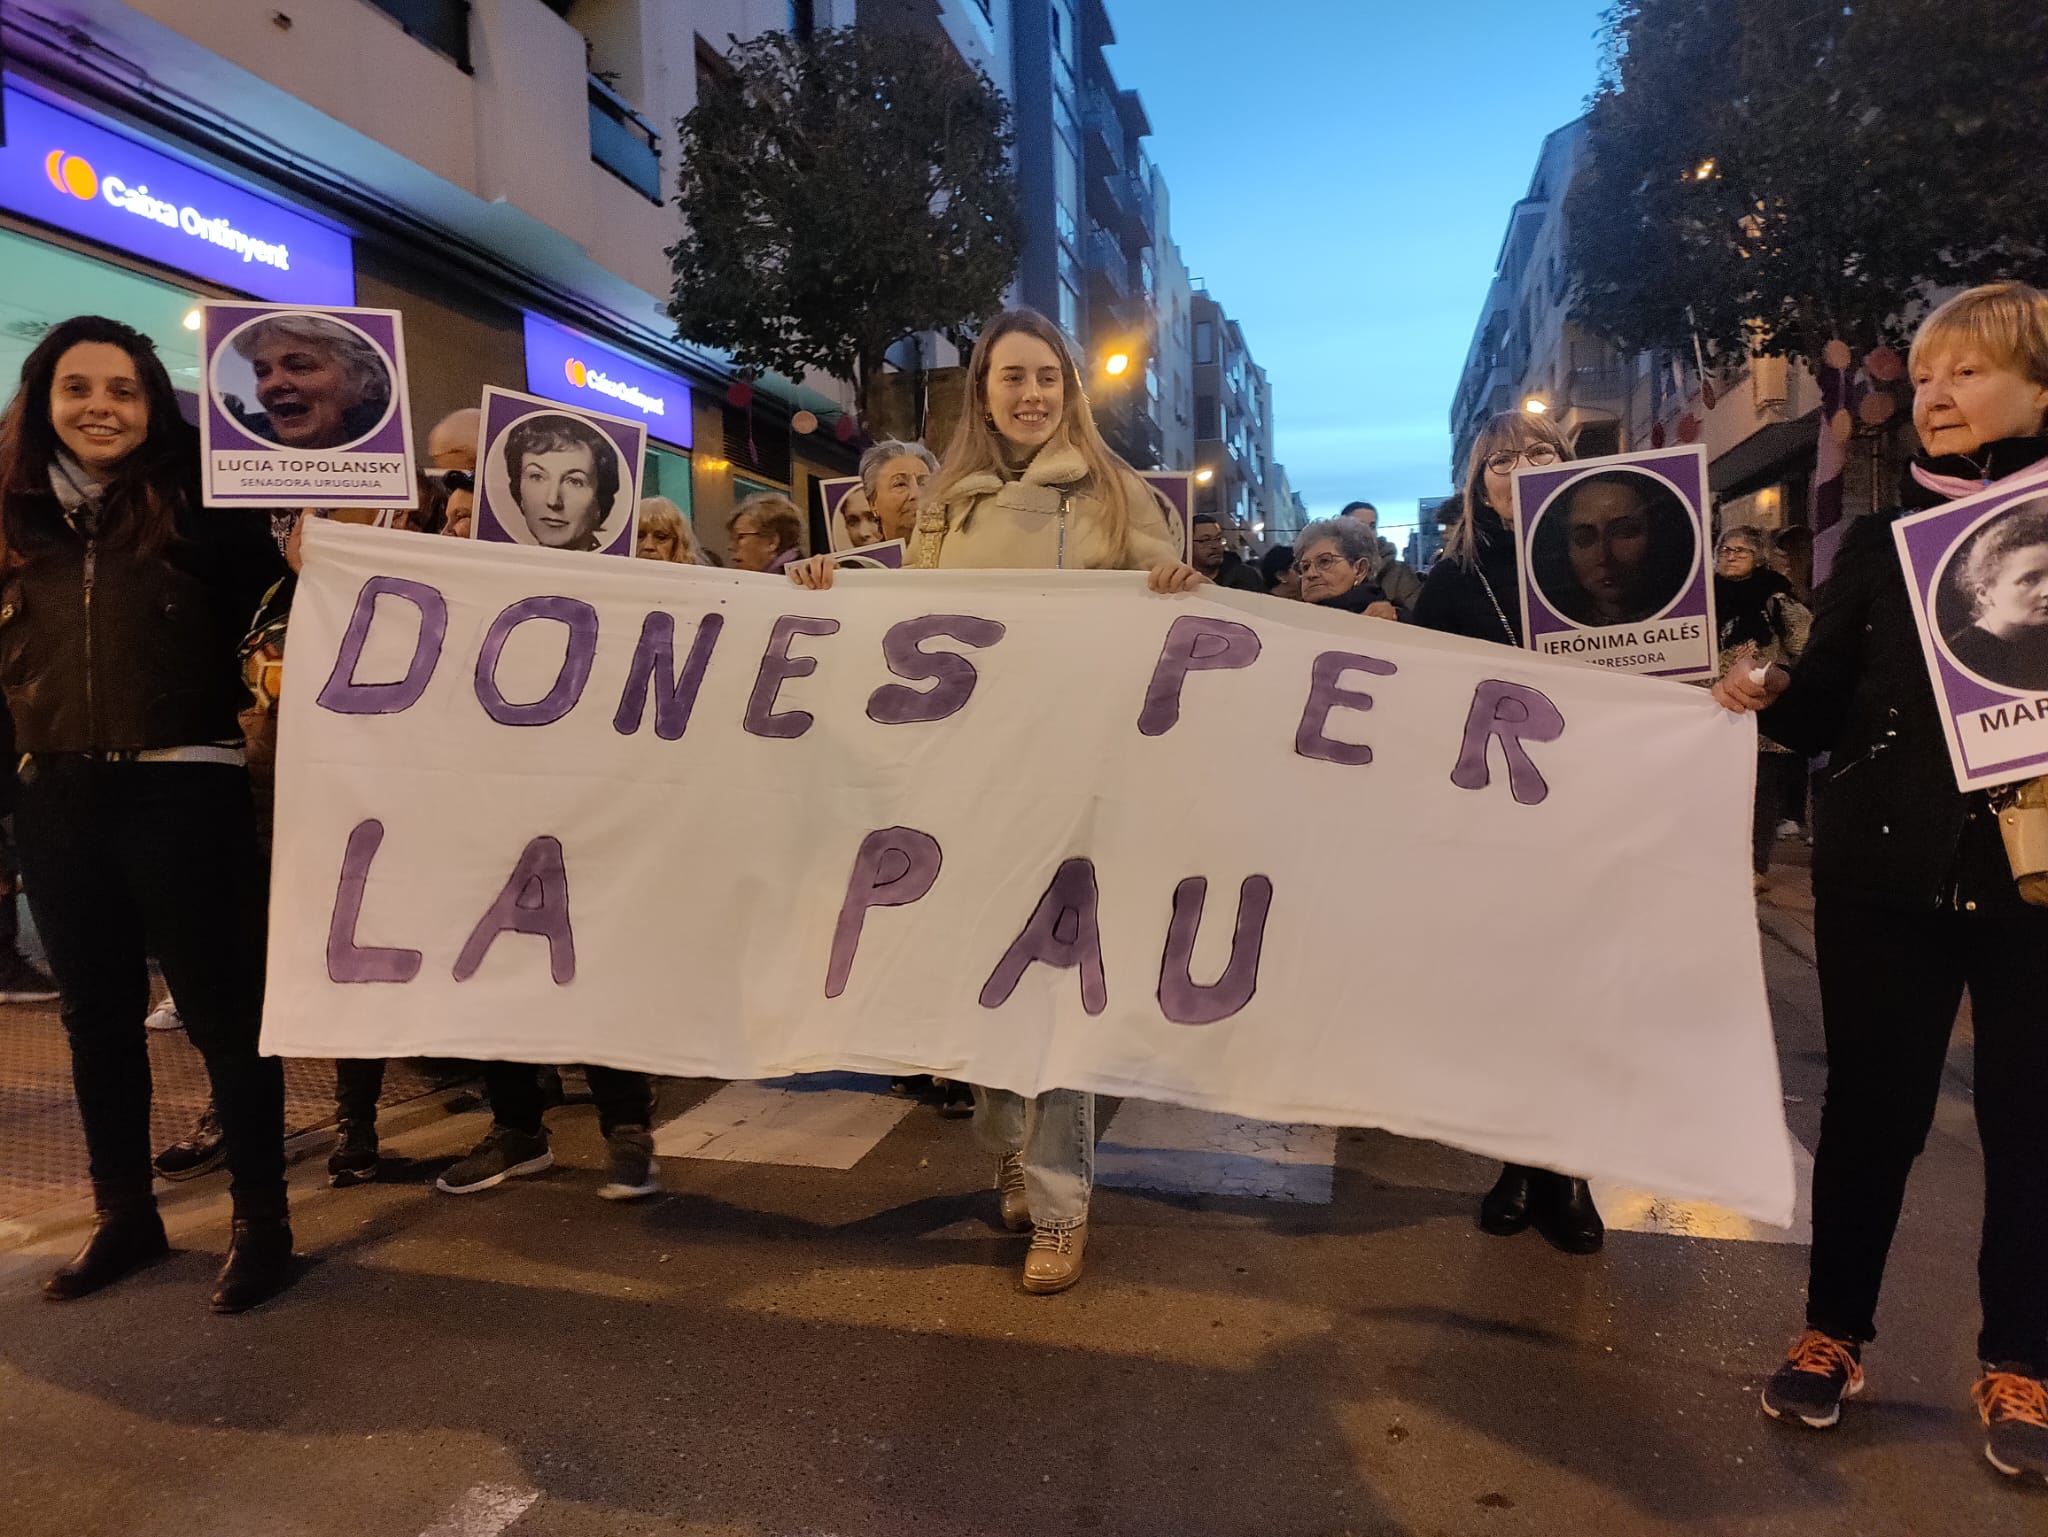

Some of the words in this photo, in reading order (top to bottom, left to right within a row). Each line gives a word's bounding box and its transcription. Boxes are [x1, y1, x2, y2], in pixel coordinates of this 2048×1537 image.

[102, 176, 179, 228] Caixa
[179, 207, 290, 271] Ontinyent
[217, 459, 273, 473] LUCIA
[279, 460, 401, 475] TOPOLANSKY
[240, 478, 311, 489] SENADORA
[314, 478, 382, 489] URUGUAIA
[1643, 622, 1700, 645] GALÉS
[316, 575, 1006, 741] DONES
[1137, 614, 1566, 806] PER
[326, 818, 577, 986] LA
[823, 825, 1274, 1026] PAU
